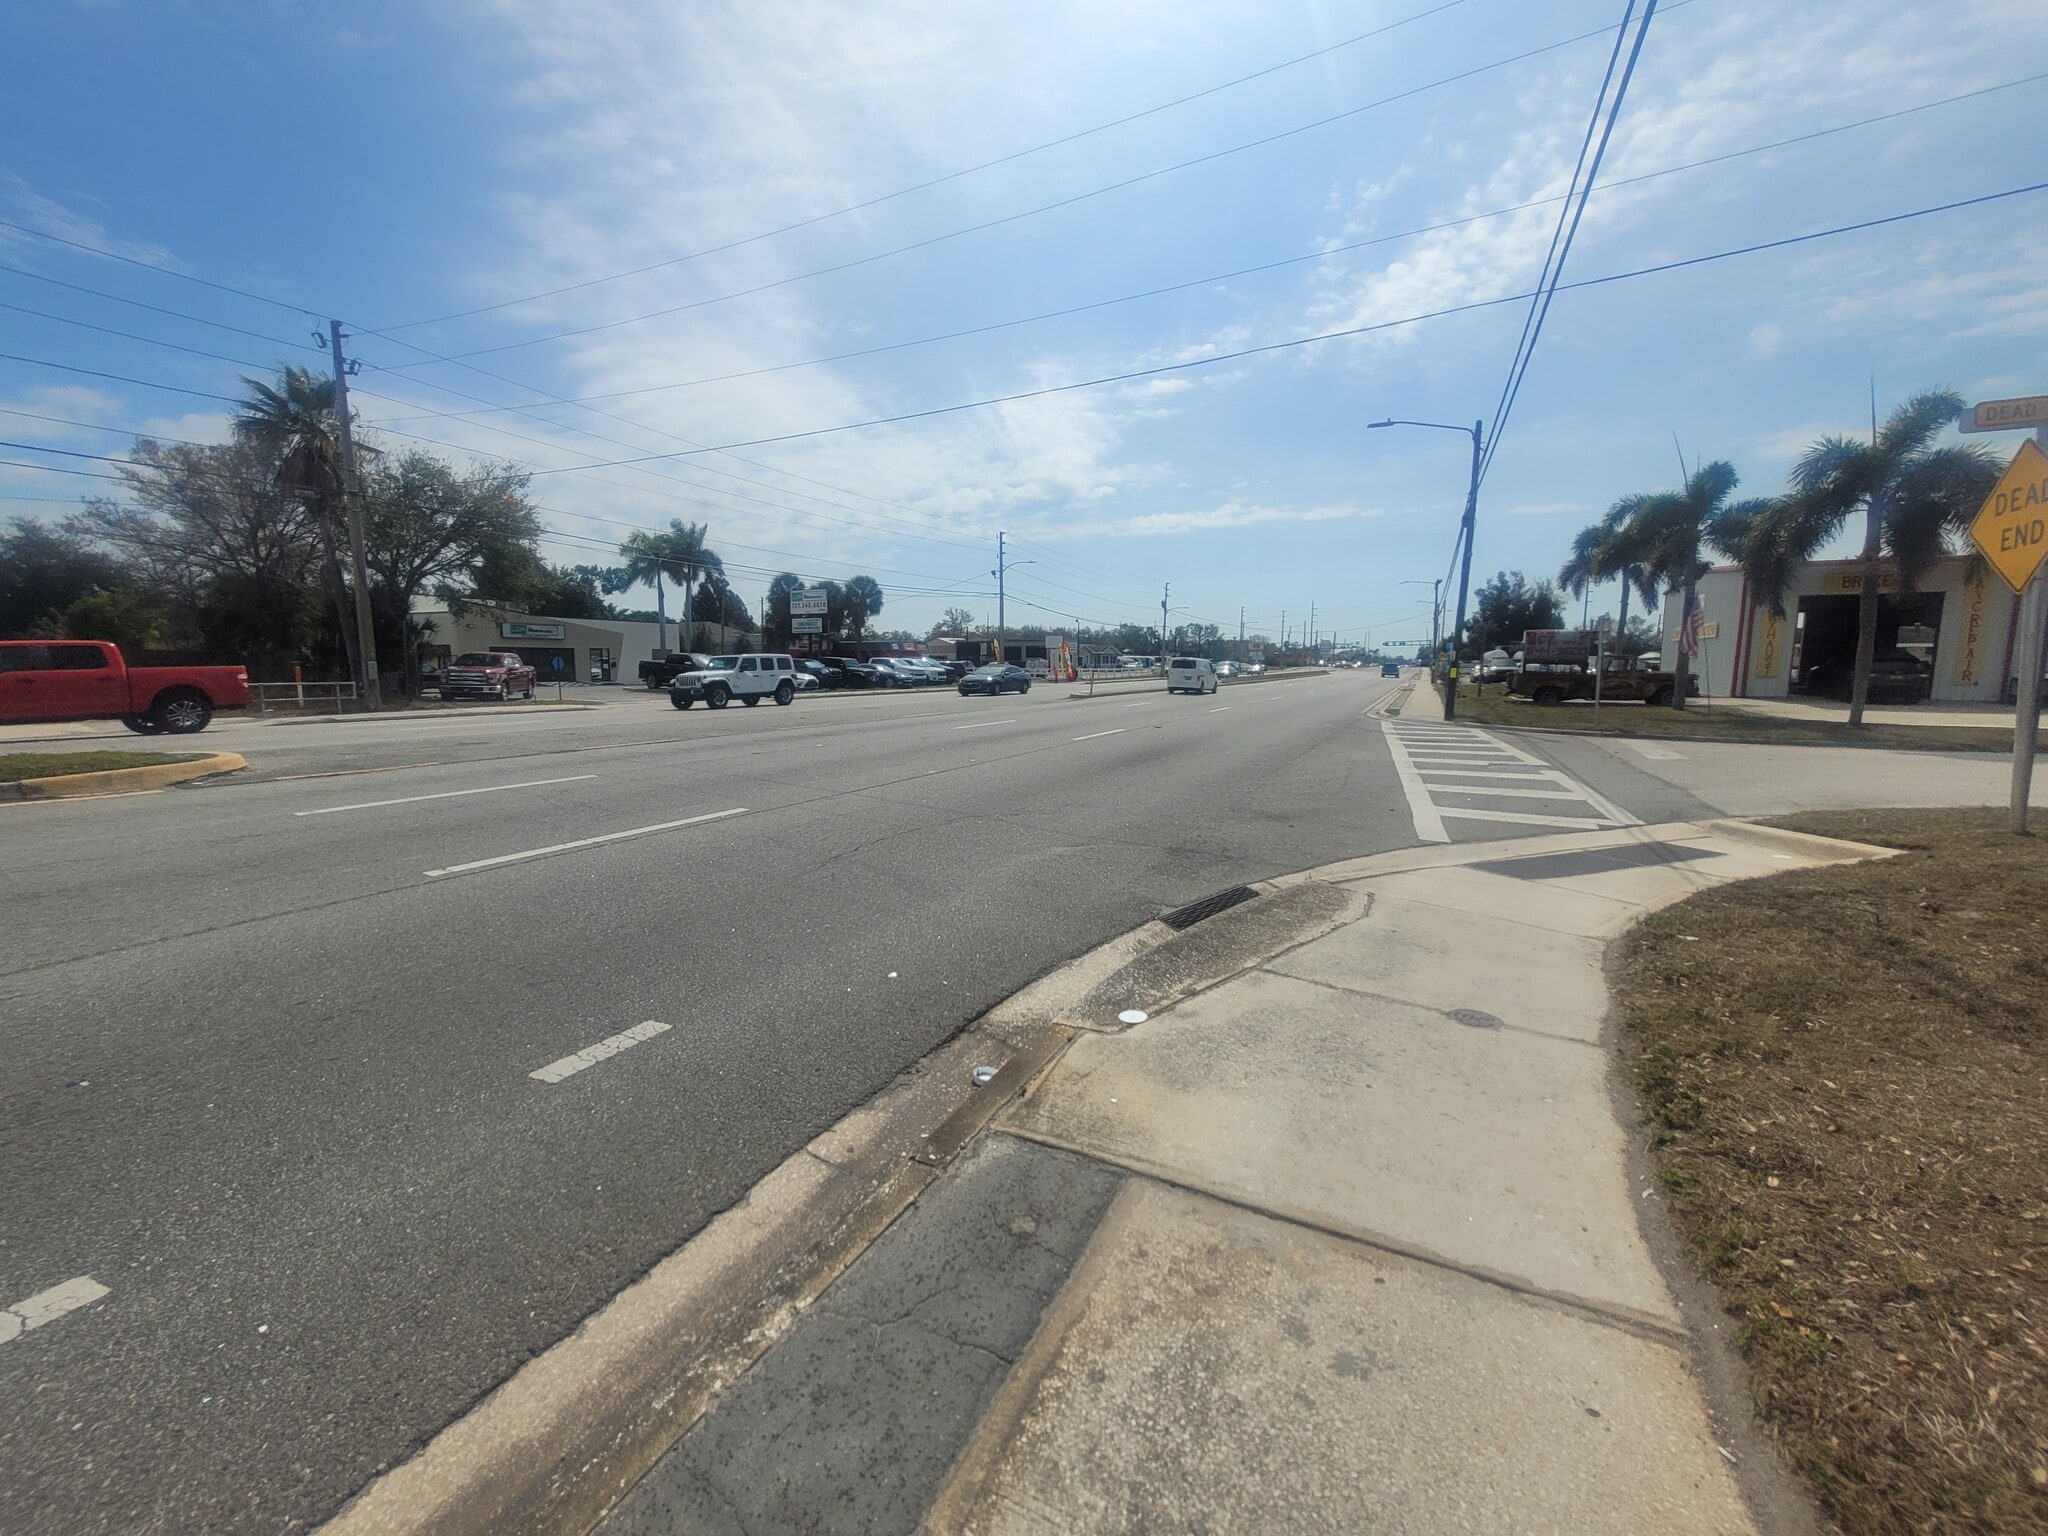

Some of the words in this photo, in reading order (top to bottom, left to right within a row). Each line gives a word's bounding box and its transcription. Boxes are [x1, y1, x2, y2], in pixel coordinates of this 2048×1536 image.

[1986, 403, 2036, 421] DEAD
[2000, 519, 2045, 552] END
[1962, 614, 1980, 682] REPAIR
